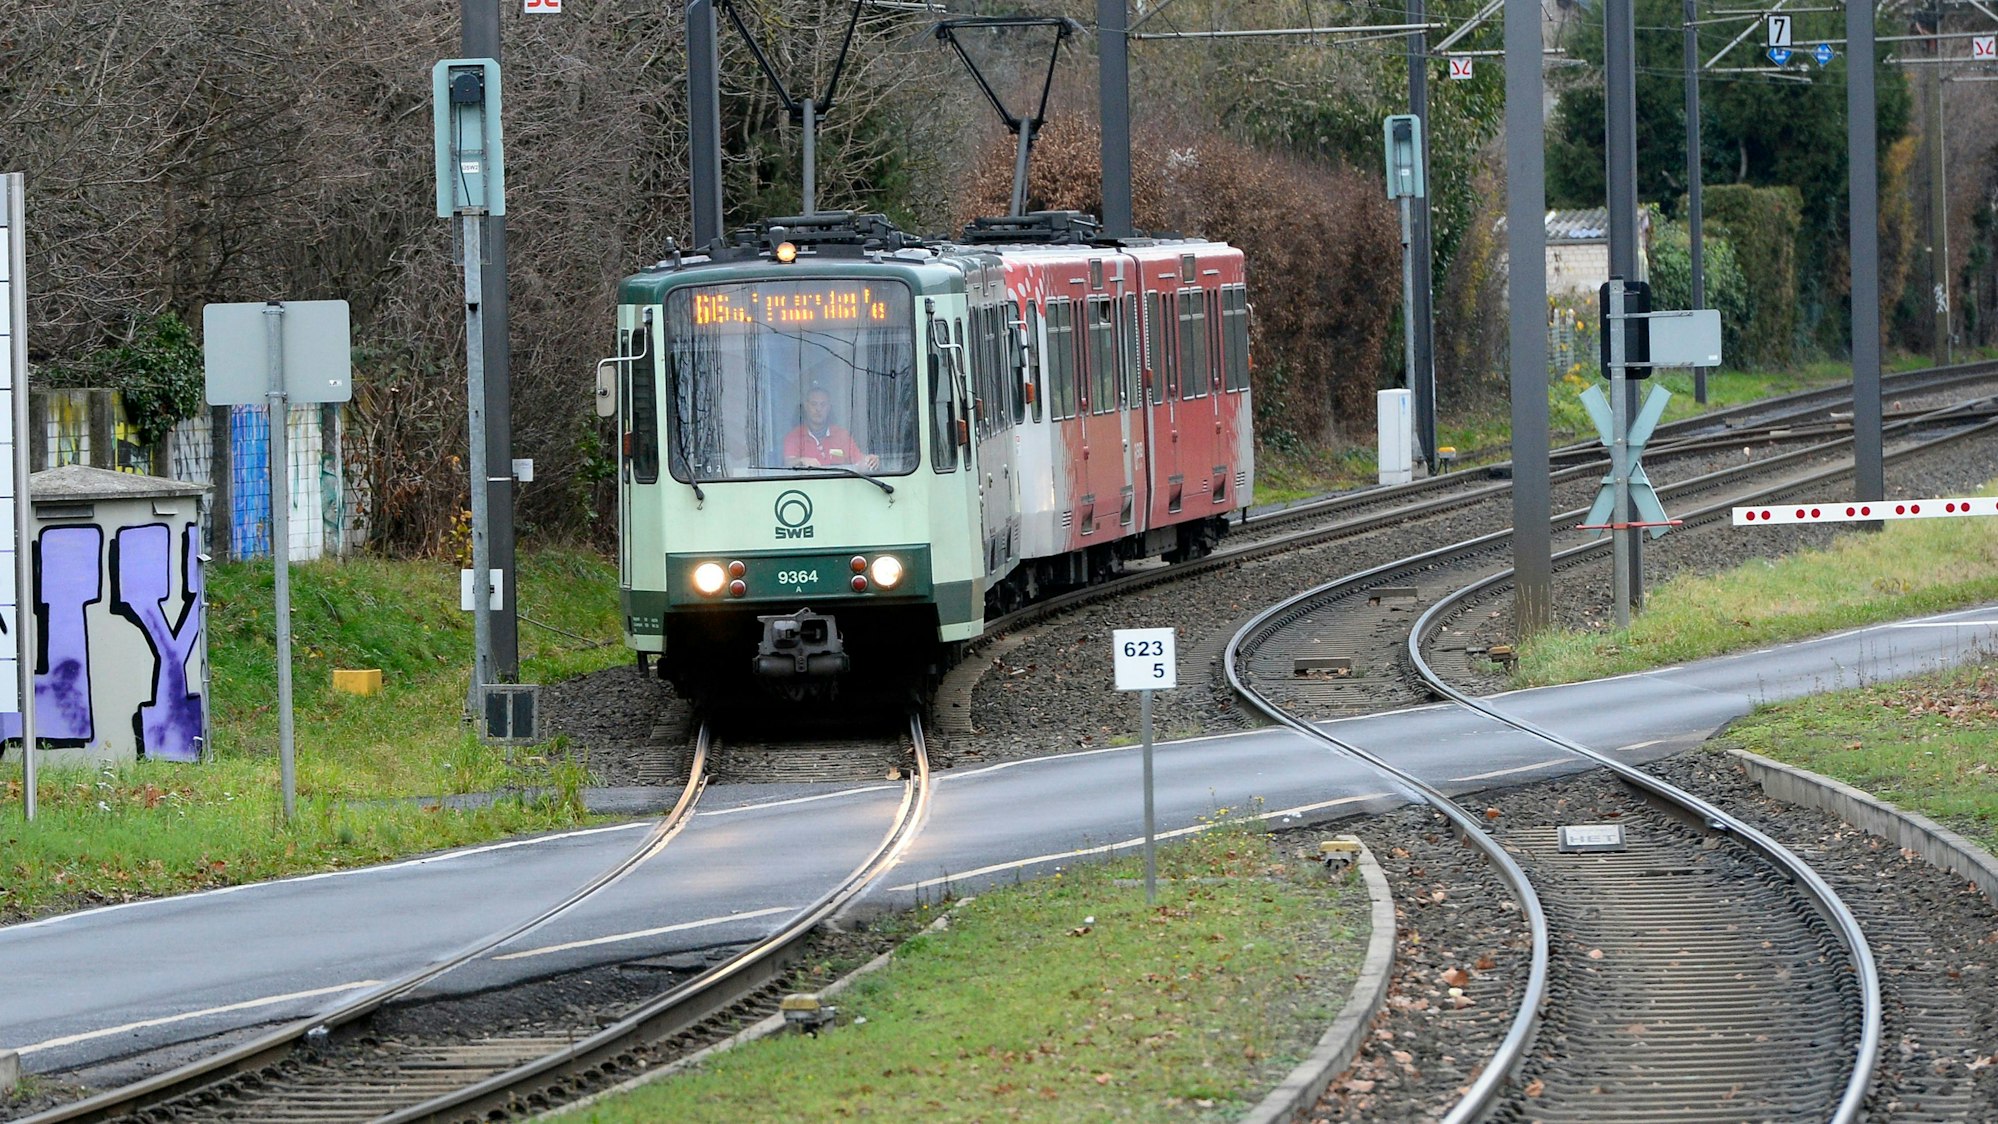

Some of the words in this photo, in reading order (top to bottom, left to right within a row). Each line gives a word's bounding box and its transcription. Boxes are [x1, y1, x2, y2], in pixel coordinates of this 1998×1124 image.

[1774, 18, 1785, 44] 7
[775, 525, 814, 539] SWB
[777, 569, 819, 584] 9364
[1124, 640, 1163, 657] 623
[1153, 663, 1164, 678] 5
